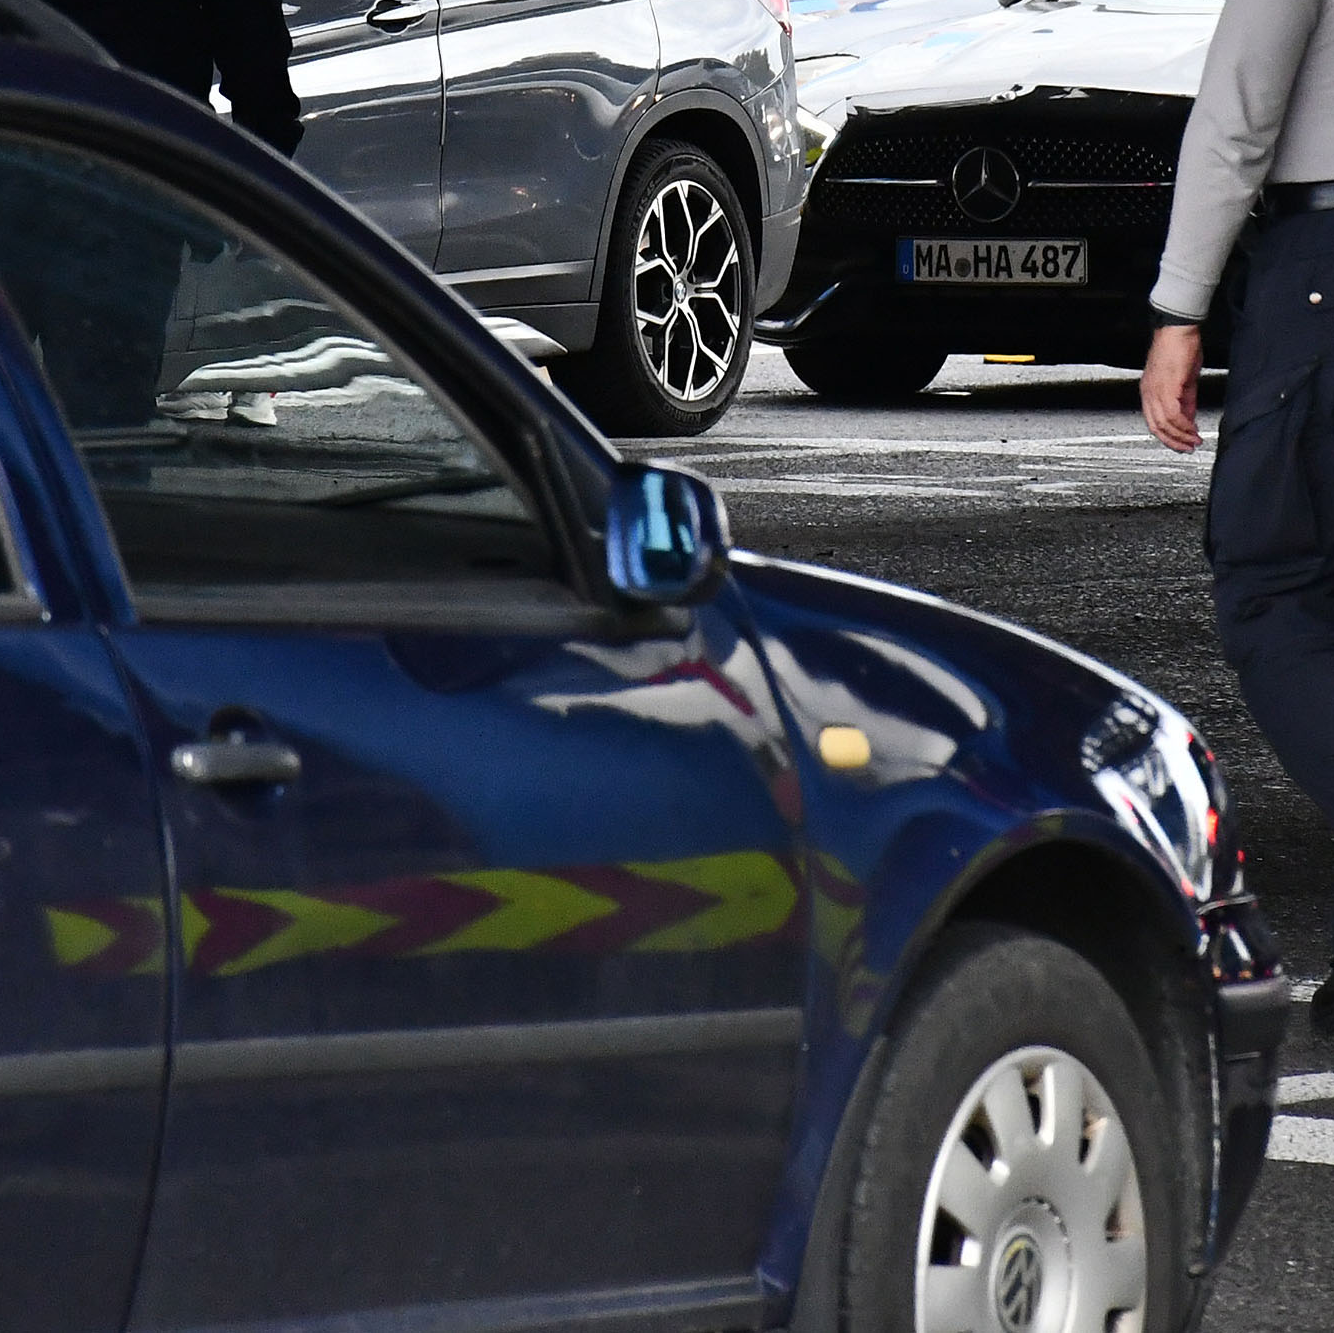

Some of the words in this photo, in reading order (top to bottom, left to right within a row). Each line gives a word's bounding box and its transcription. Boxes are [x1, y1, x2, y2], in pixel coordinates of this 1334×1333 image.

[915, 244, 952, 278] MA
[973, 244, 1013, 278] HA
[1020, 244, 1082, 278] 487
